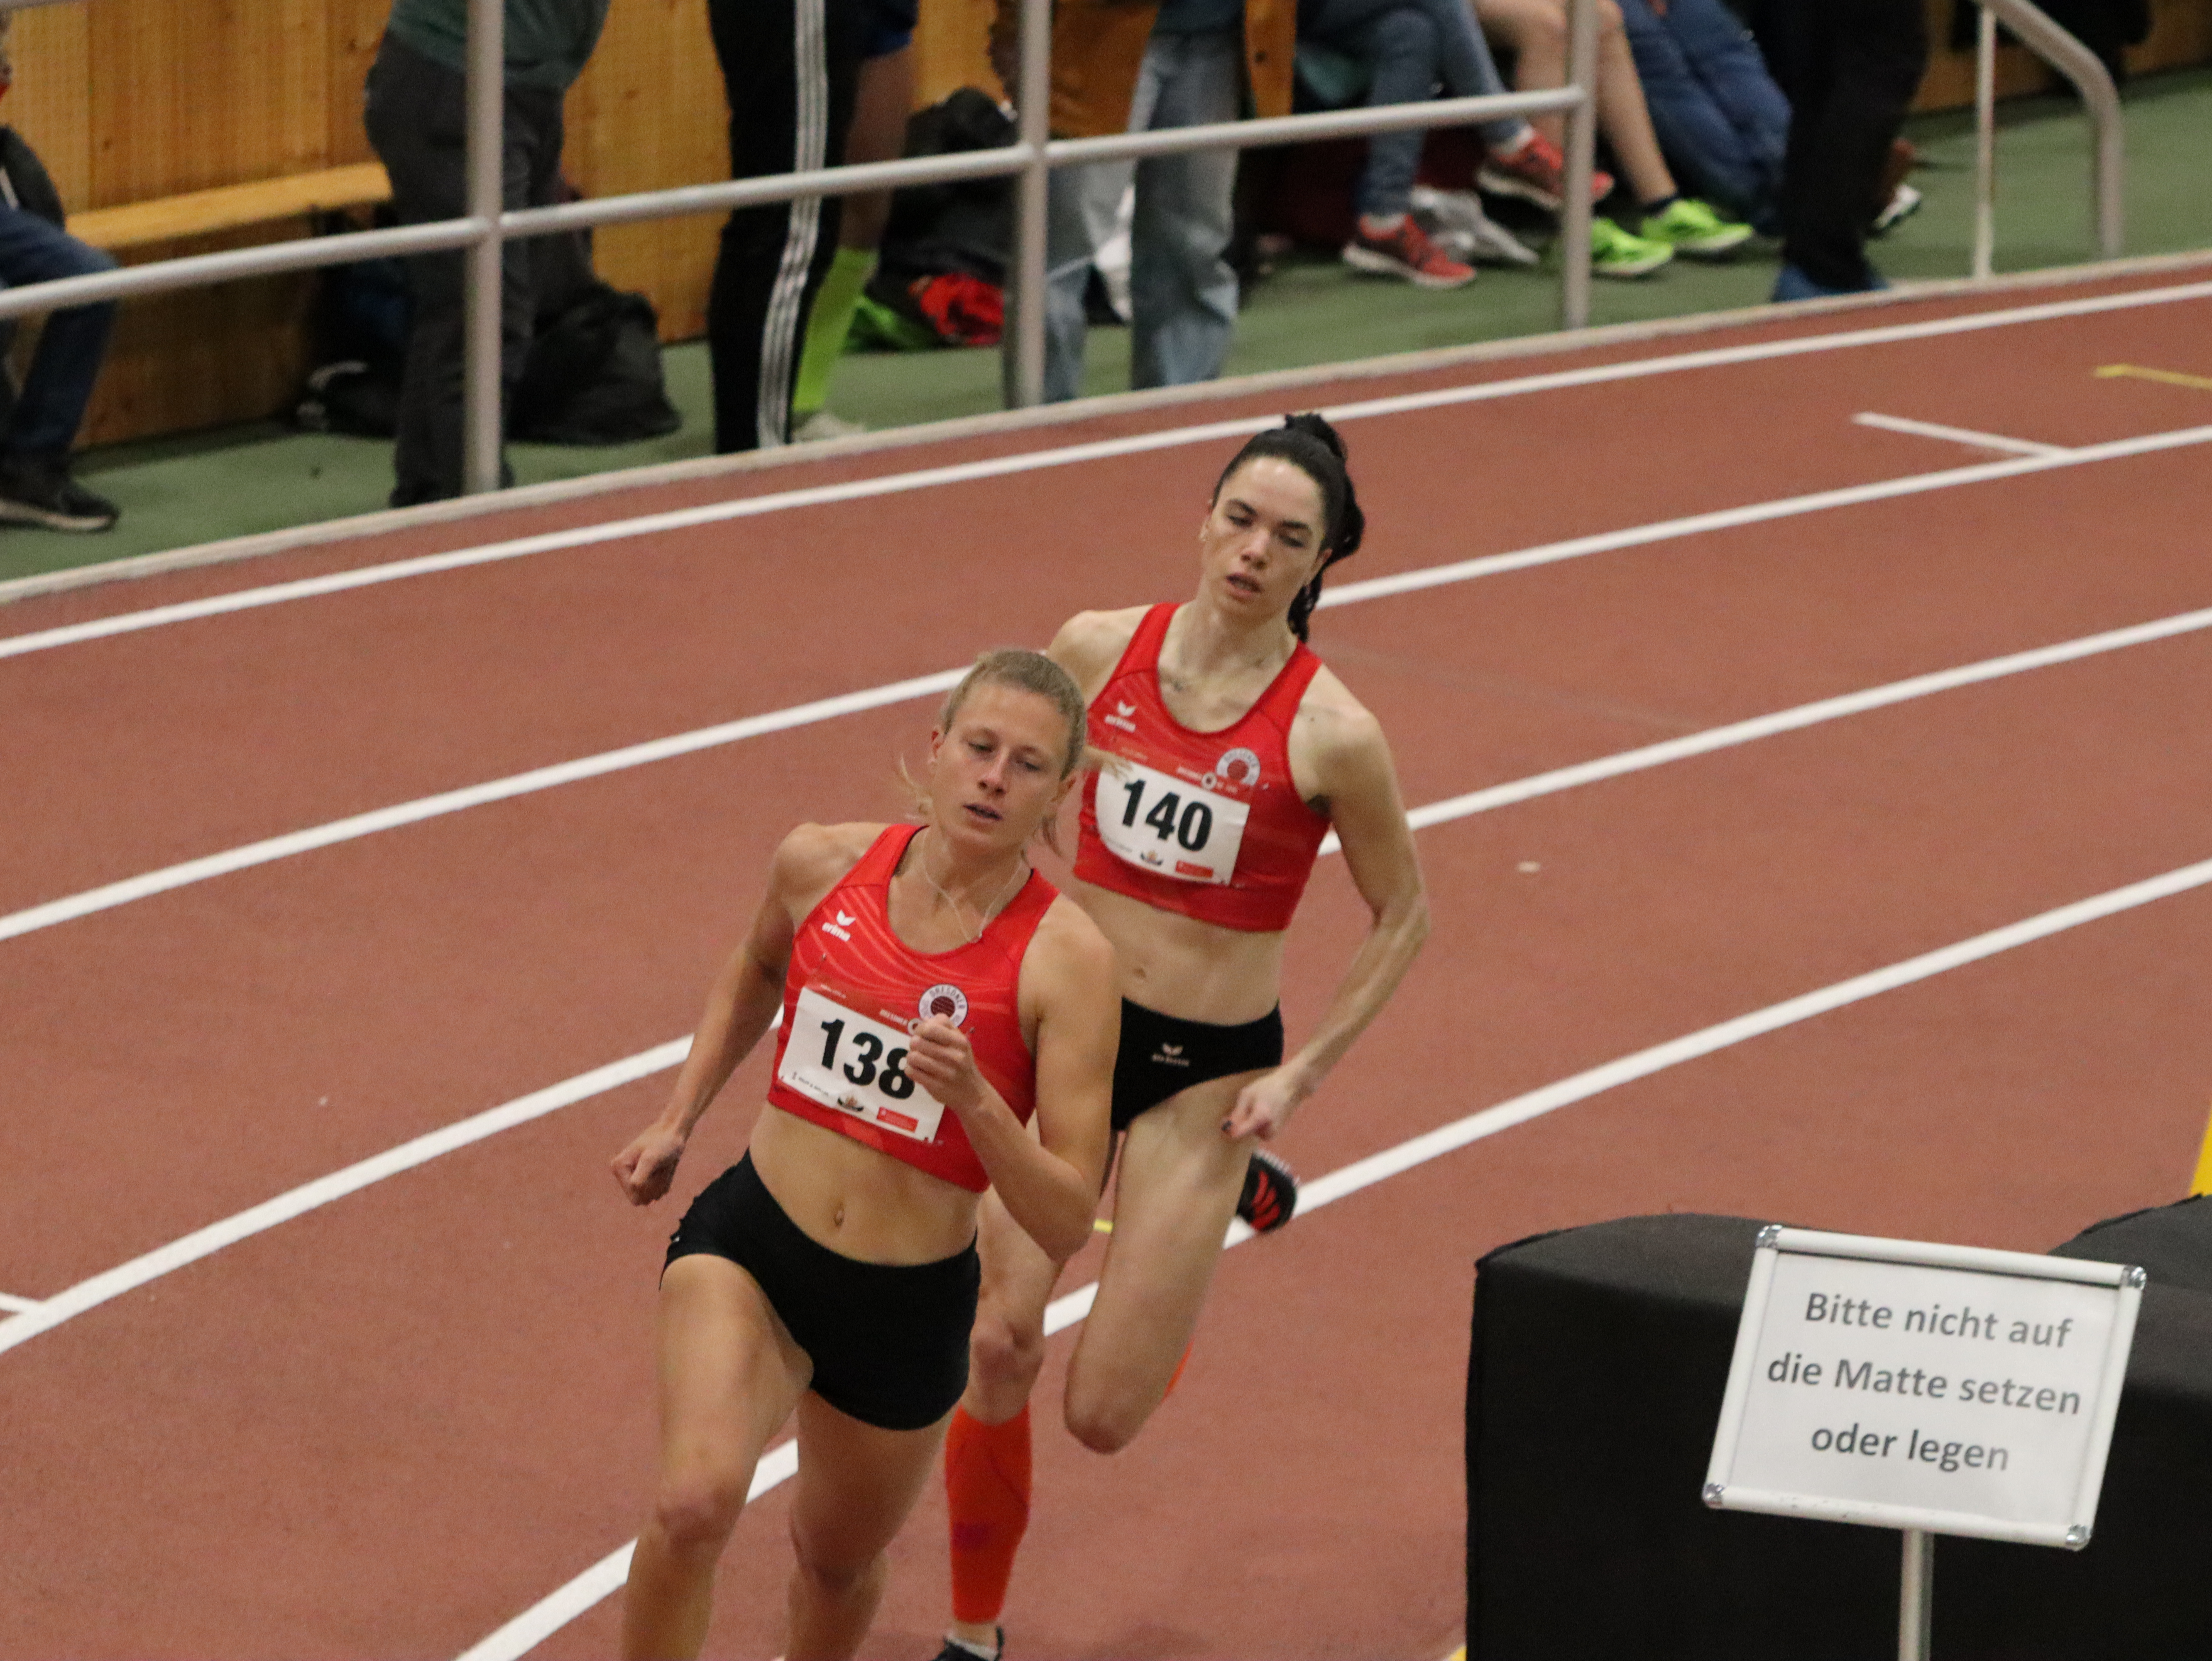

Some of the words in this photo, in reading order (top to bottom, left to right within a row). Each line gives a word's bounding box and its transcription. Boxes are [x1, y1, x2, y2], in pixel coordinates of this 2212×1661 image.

[1123, 779, 1213, 851] 140
[821, 1019, 915, 1099] 138
[1805, 1292, 1892, 1329] Bitte
[1905, 1304, 1999, 1341] nicht
[2008, 1318, 2074, 1348] auf
[1767, 1352, 1822, 1386] die
[1834, 1359, 1948, 1398] Matte
[1958, 1377, 2081, 1415] setzen
[1811, 1423, 1897, 1457] oder
[1907, 1429, 2009, 1472] legen
